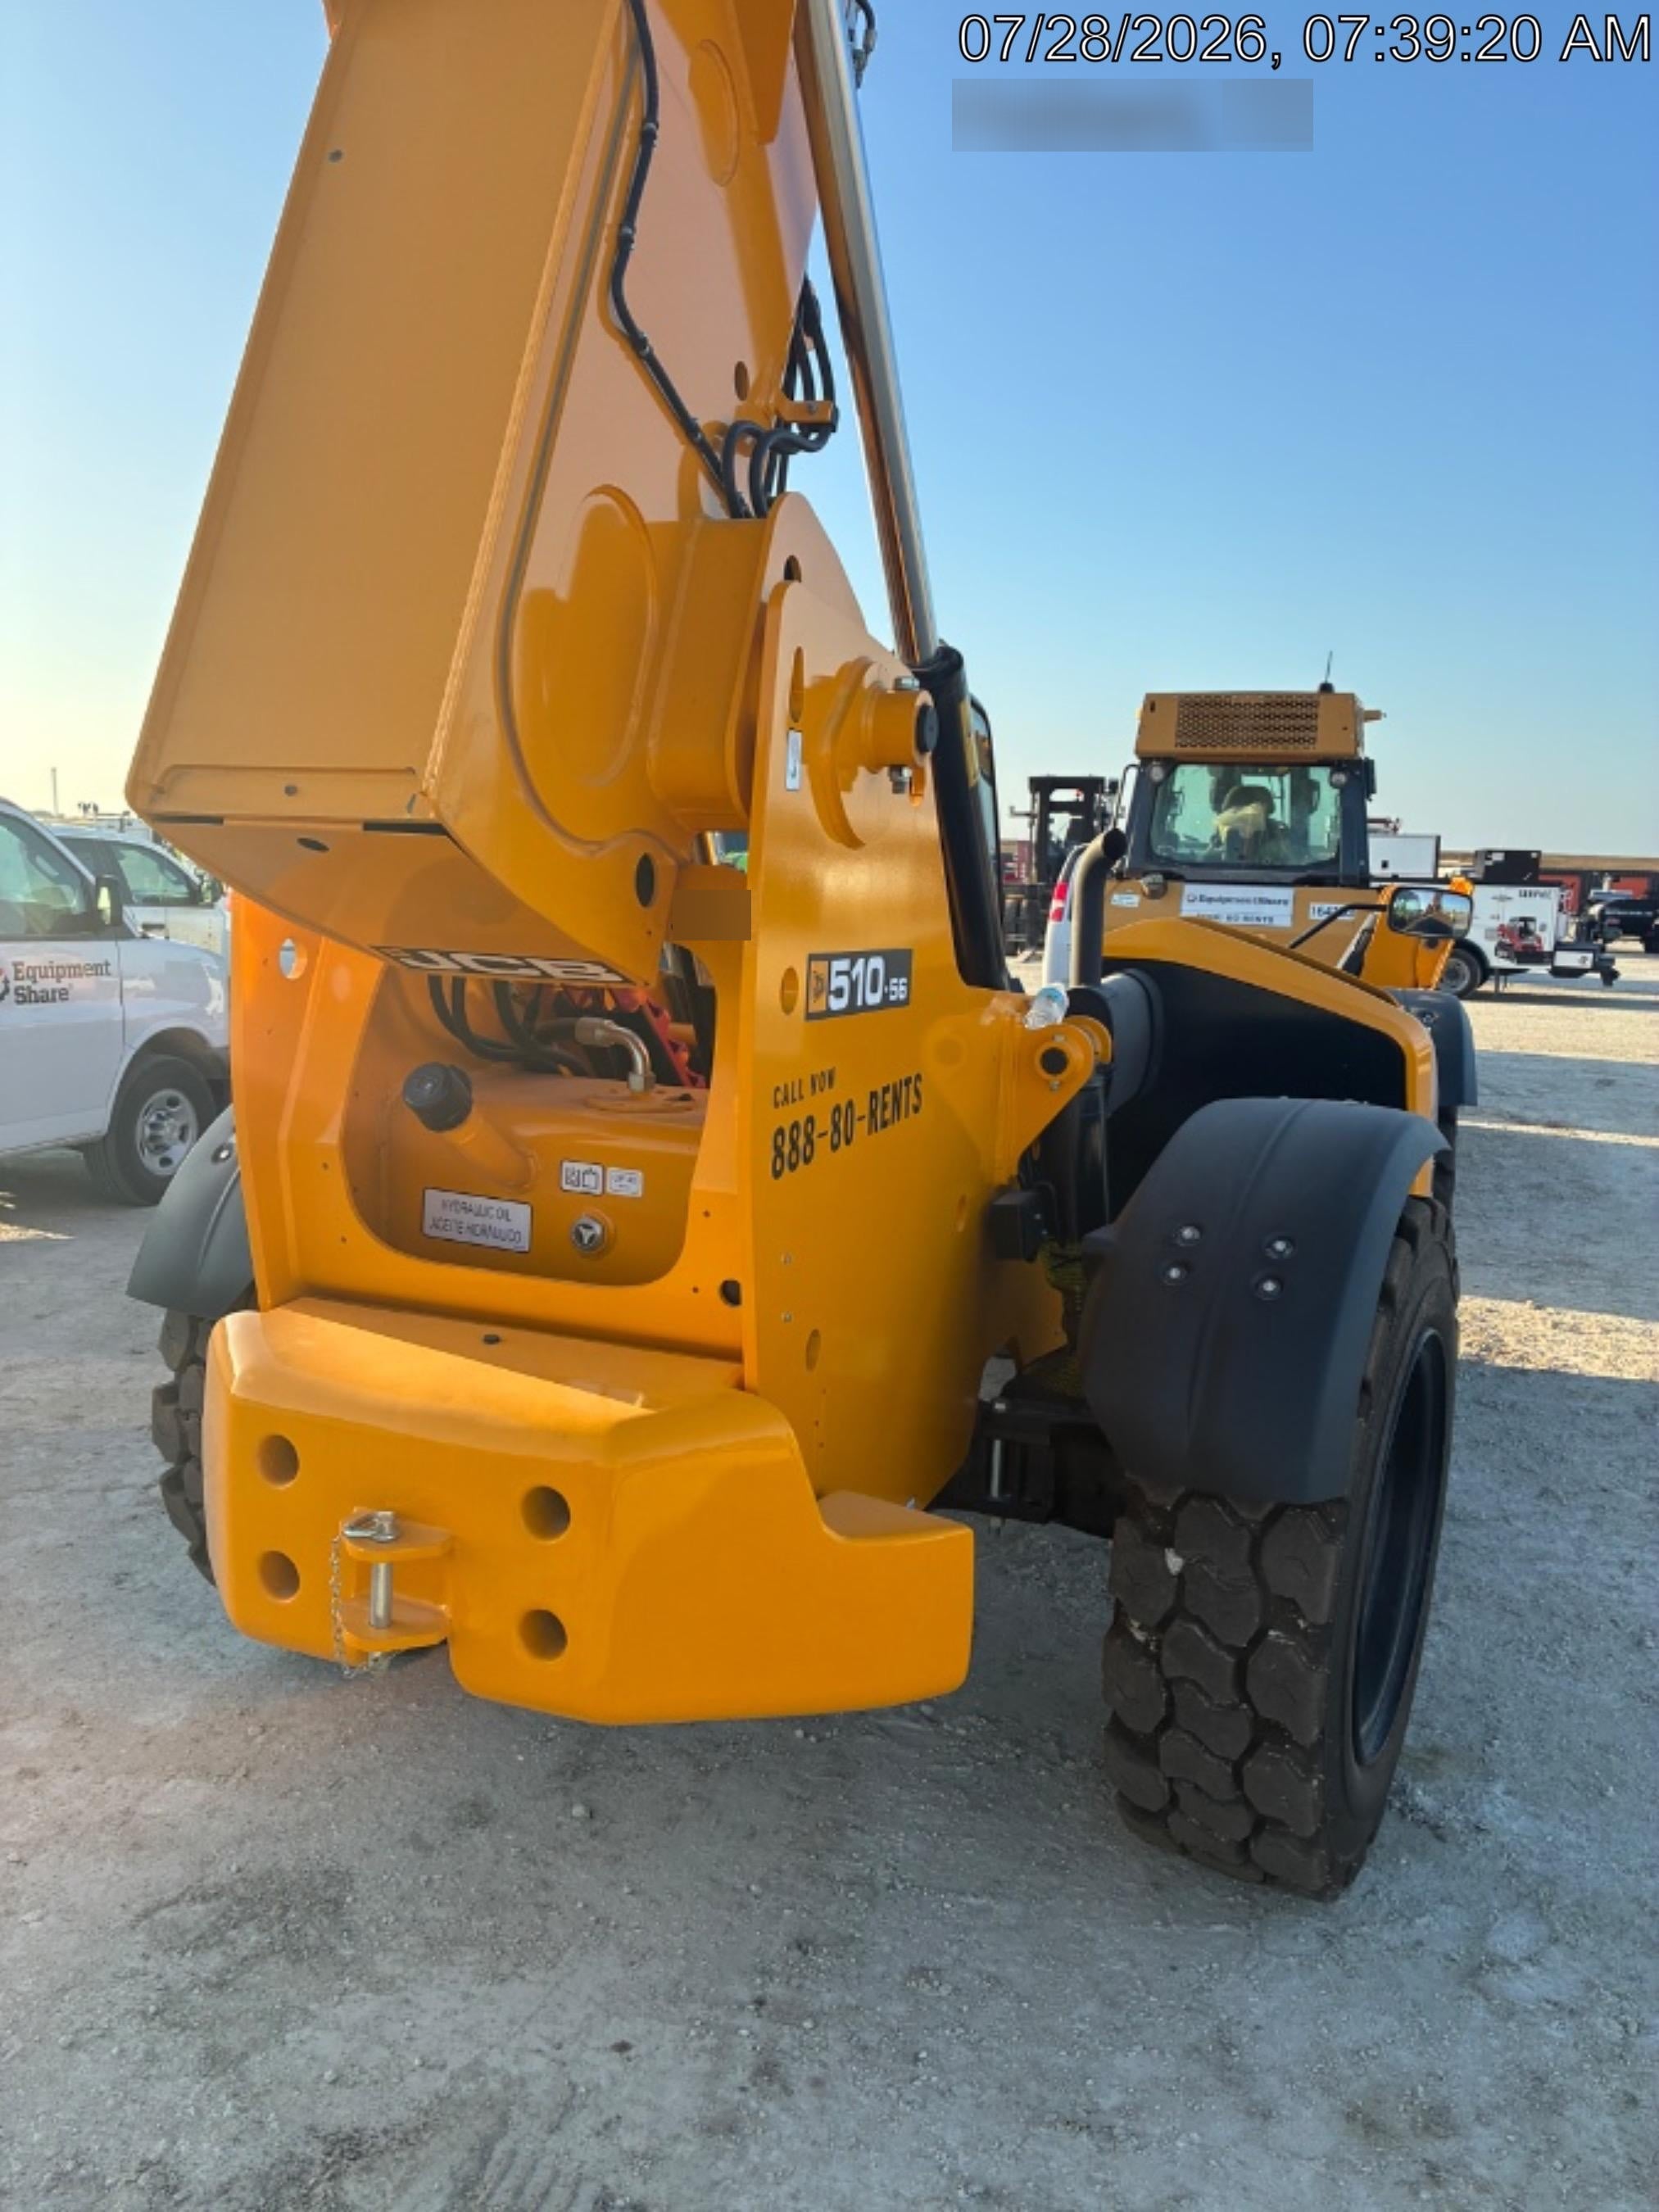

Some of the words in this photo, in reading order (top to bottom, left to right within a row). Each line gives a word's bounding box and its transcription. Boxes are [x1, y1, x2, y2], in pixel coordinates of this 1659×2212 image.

[11, 959, 111, 983] Equipment
[398, 949, 623, 982] JCB
[14, 985, 70, 1004] Share
[773, 1078, 805, 1109] CALL
[810, 1067, 836, 1097] NOW
[772, 1072, 923, 1180] 888-80-RENTS
